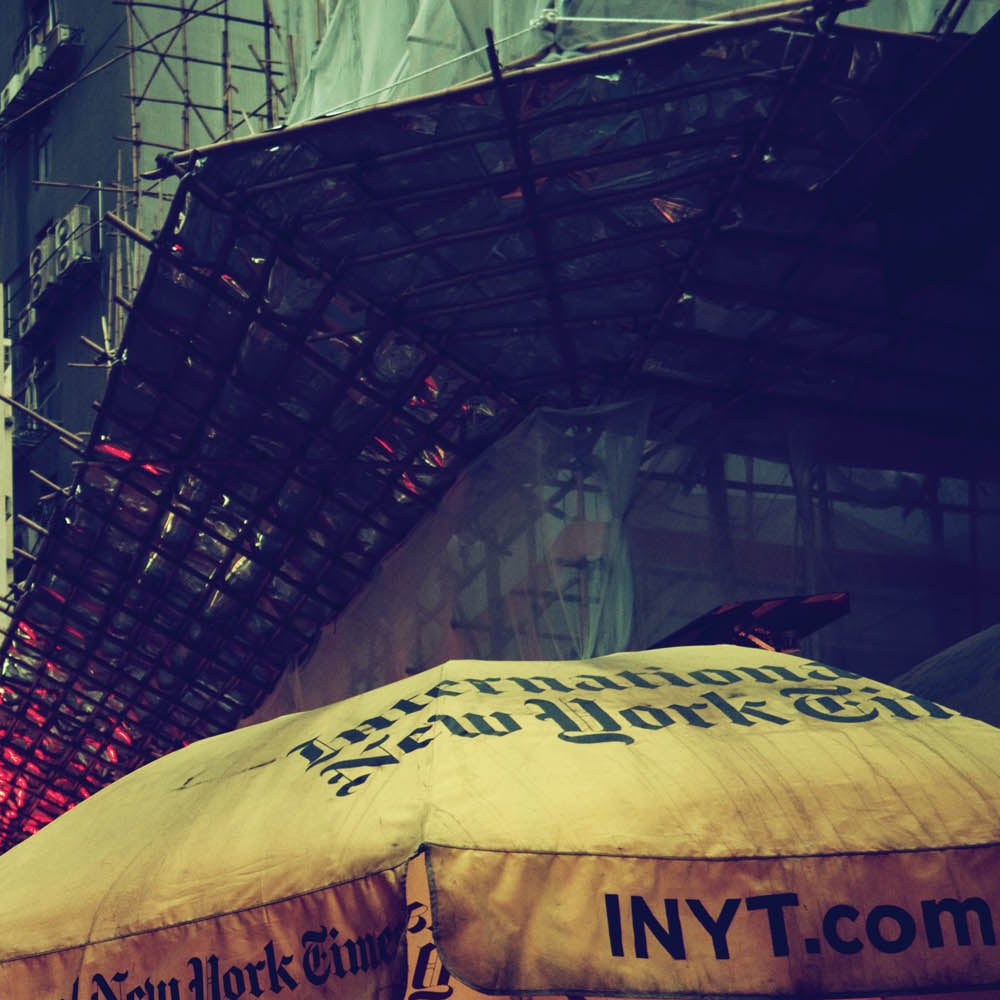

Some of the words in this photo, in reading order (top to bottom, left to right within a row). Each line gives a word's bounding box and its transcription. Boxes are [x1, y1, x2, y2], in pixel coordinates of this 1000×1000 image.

[320, 711, 522, 797] New
[525, 691, 791, 745] York
[604, 892, 997, 960] INYT.com
